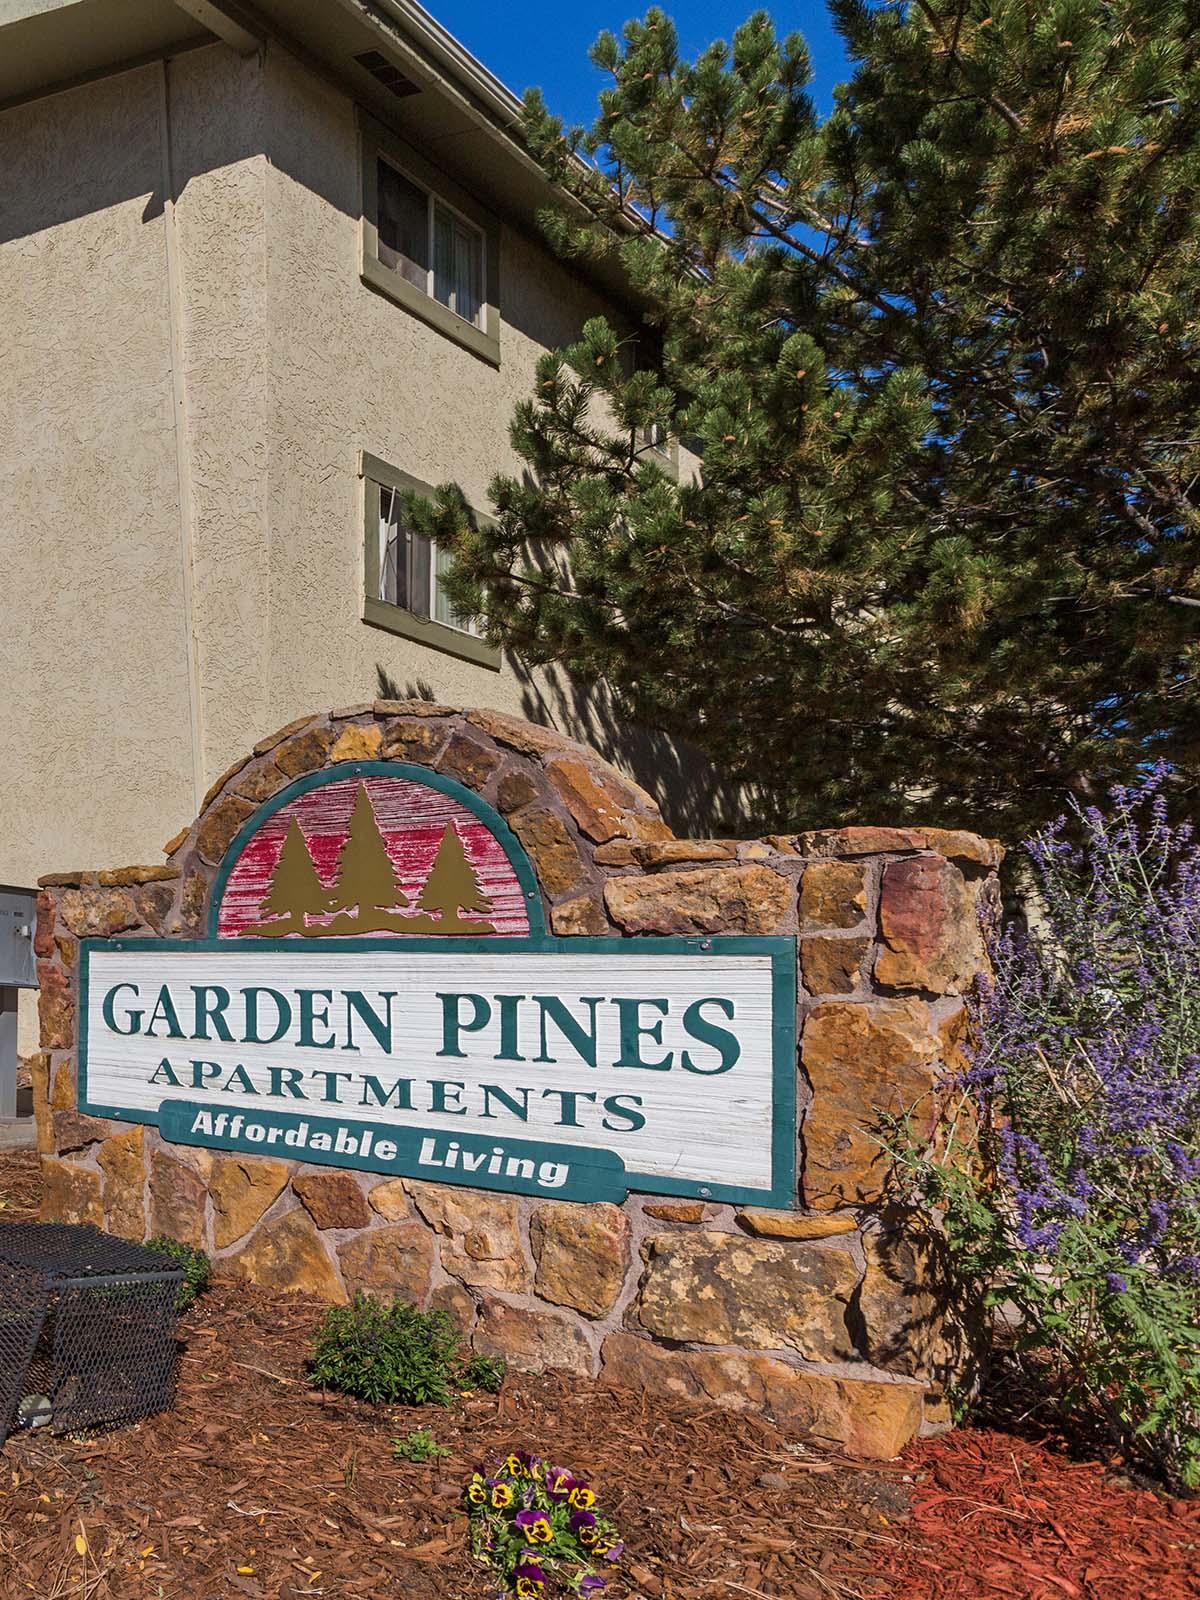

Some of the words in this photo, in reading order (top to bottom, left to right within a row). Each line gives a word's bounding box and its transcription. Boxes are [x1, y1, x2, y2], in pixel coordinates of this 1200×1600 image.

[102, 982, 398, 1055] GARDEN
[435, 992, 741, 1076] PINES
[147, 1057, 647, 1132] APARTMENTS
[190, 1110, 398, 1161] Affordable
[418, 1137, 570, 1188] Living
